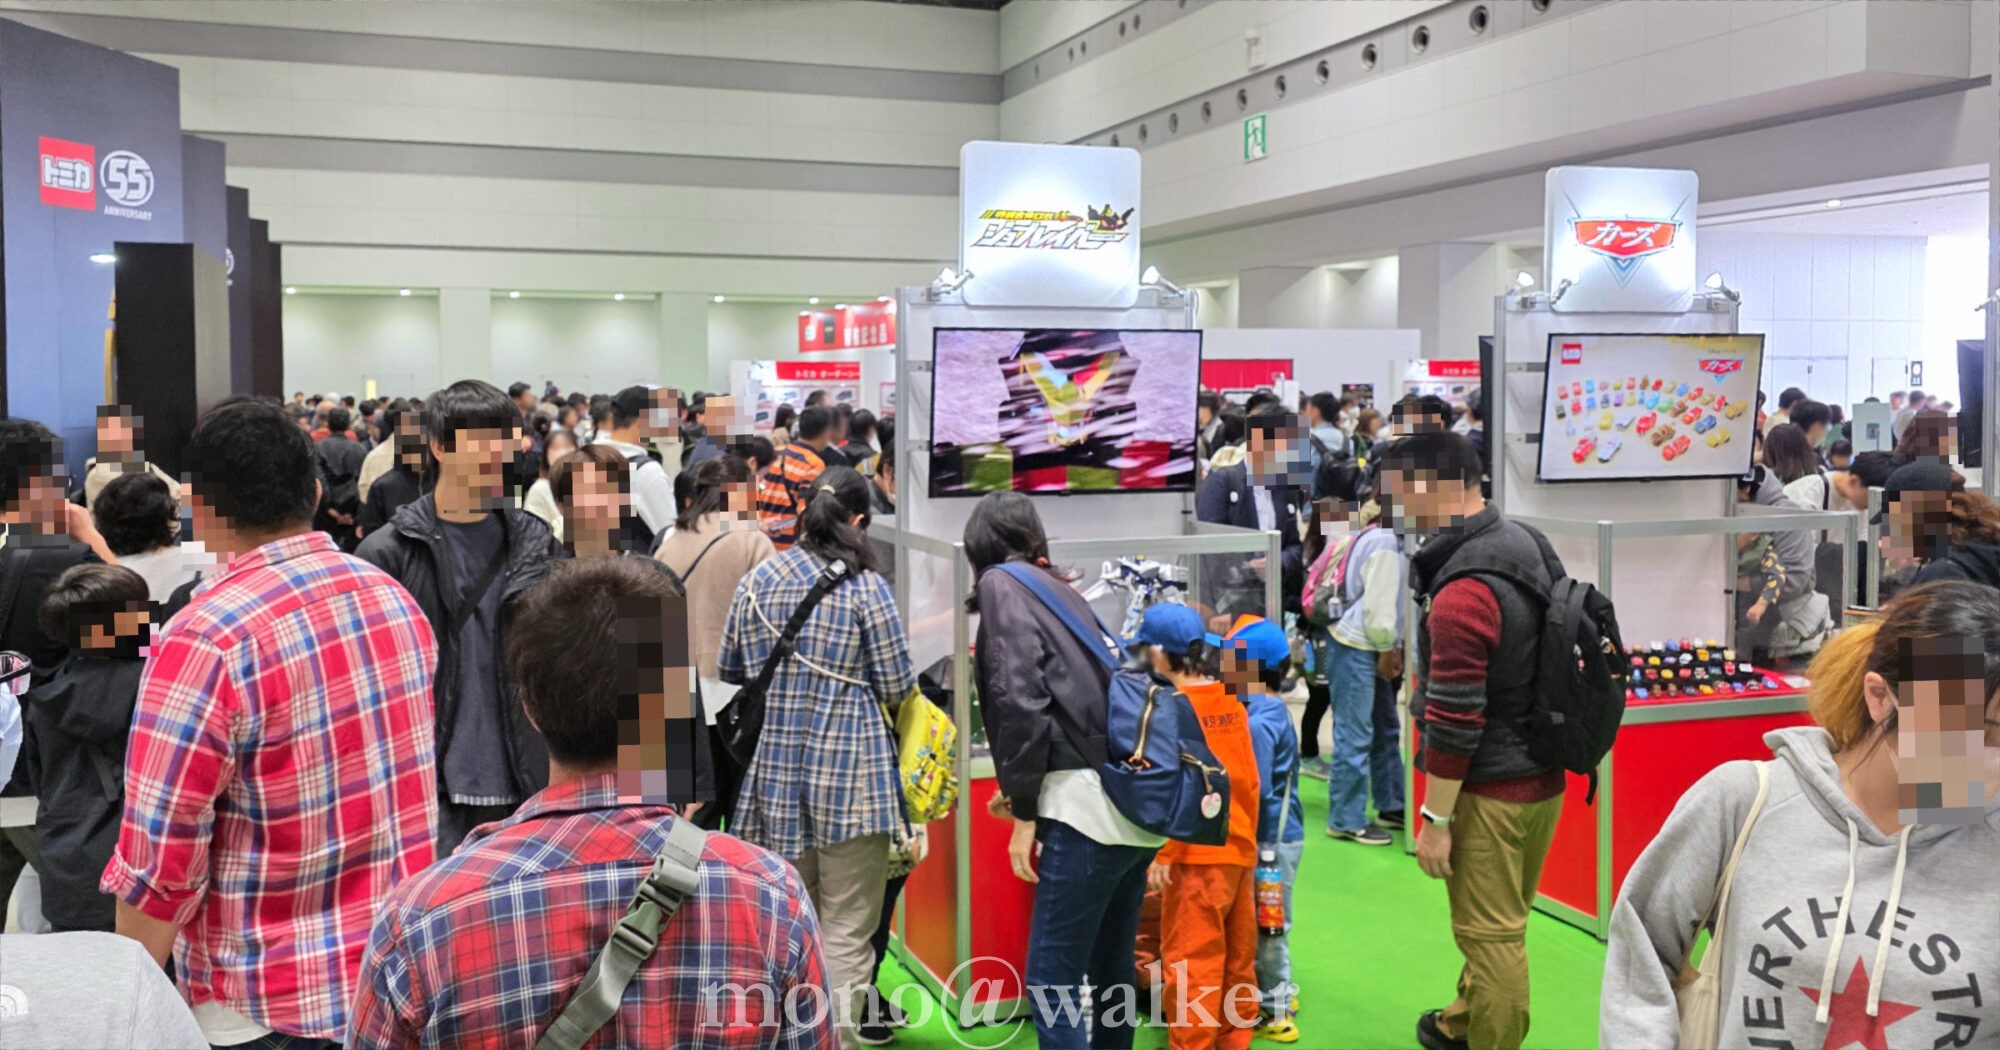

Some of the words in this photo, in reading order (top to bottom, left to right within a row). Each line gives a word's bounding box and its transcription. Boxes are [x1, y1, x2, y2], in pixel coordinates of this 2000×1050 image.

[41, 154, 93, 193] トミカ
[107, 158, 152, 201] 55
[104, 205, 153, 221] ANNIVERSARY
[1588, 222, 1662, 249] カーズ
